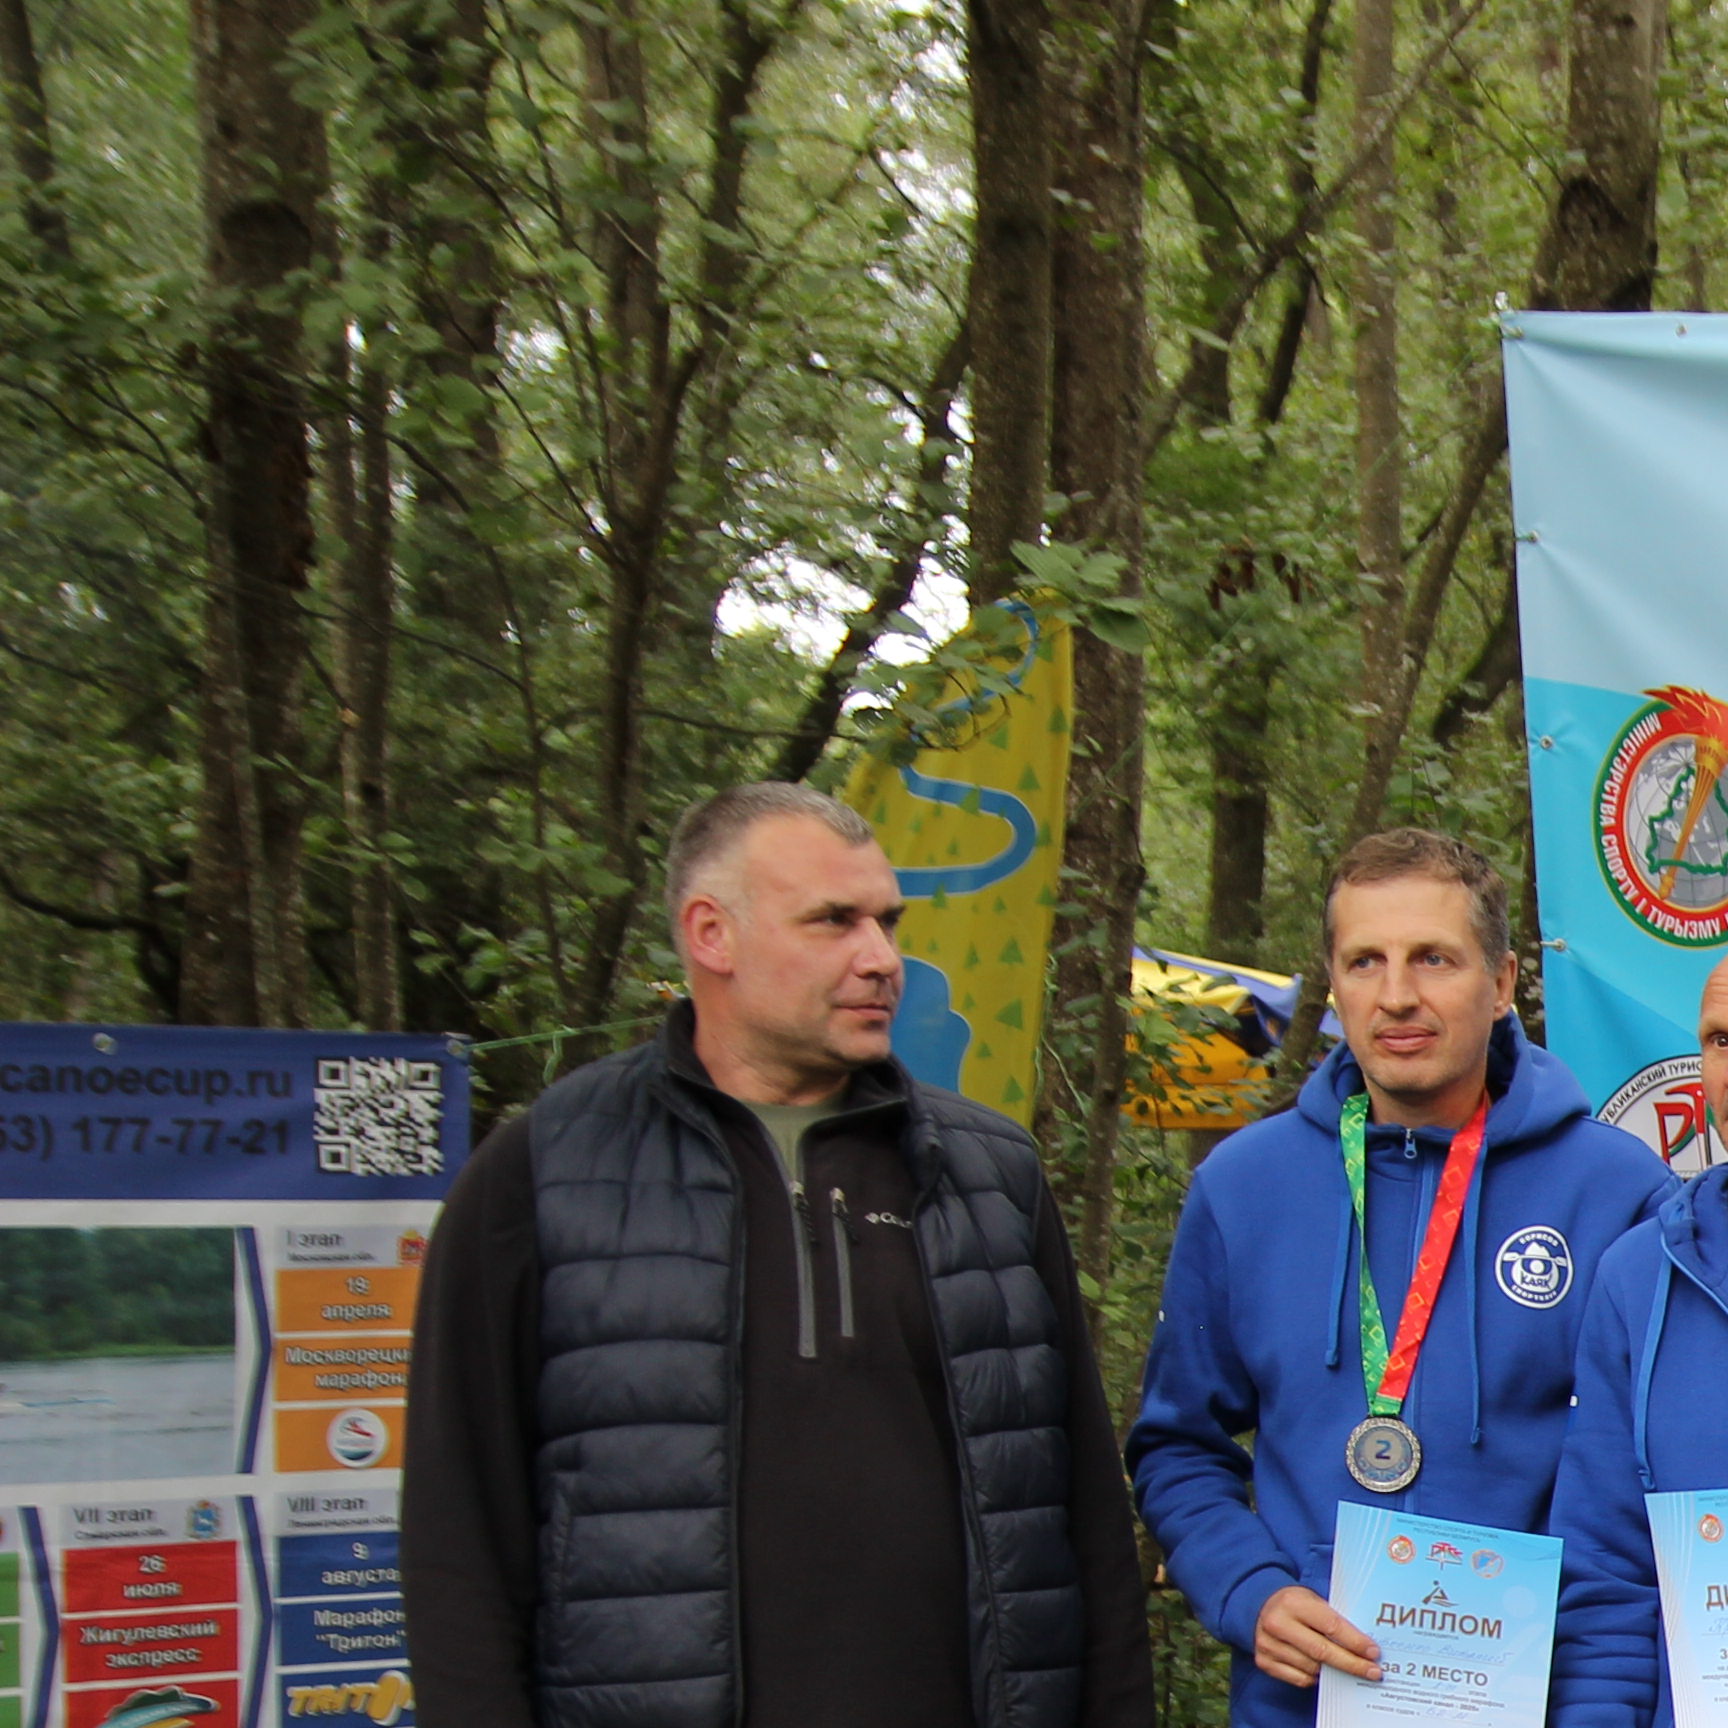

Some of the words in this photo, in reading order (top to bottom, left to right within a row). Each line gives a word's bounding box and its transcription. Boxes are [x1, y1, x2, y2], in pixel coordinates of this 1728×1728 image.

[1599, 711, 1662, 827] МІНІСТЭРСТВА
[1600, 833, 1641, 902] СПОРТУ
[1646, 904, 1721, 940] ТУРЫЗМУ
[1, 1064, 294, 1106] canoecup.ru
[71, 1116, 291, 1156] 177-77-21
[321, 1303, 393, 1323] апреля
[1375, 1440, 1392, 1460] 2
[106, 1507, 154, 1524] этап
[321, 1496, 366, 1513] этап
[123, 1581, 182, 1597] июля
[321, 1566, 402, 1587] августа
[80, 1619, 219, 1647] Жигулевский
[1376, 1603, 1503, 1640] ДИПЛОМ
[105, 1648, 203, 1669] экспресс
[1381, 1661, 1400, 1674] за
[1406, 1662, 1417, 1676] 2
[1422, 1665, 1489, 1687] МЕСТО
